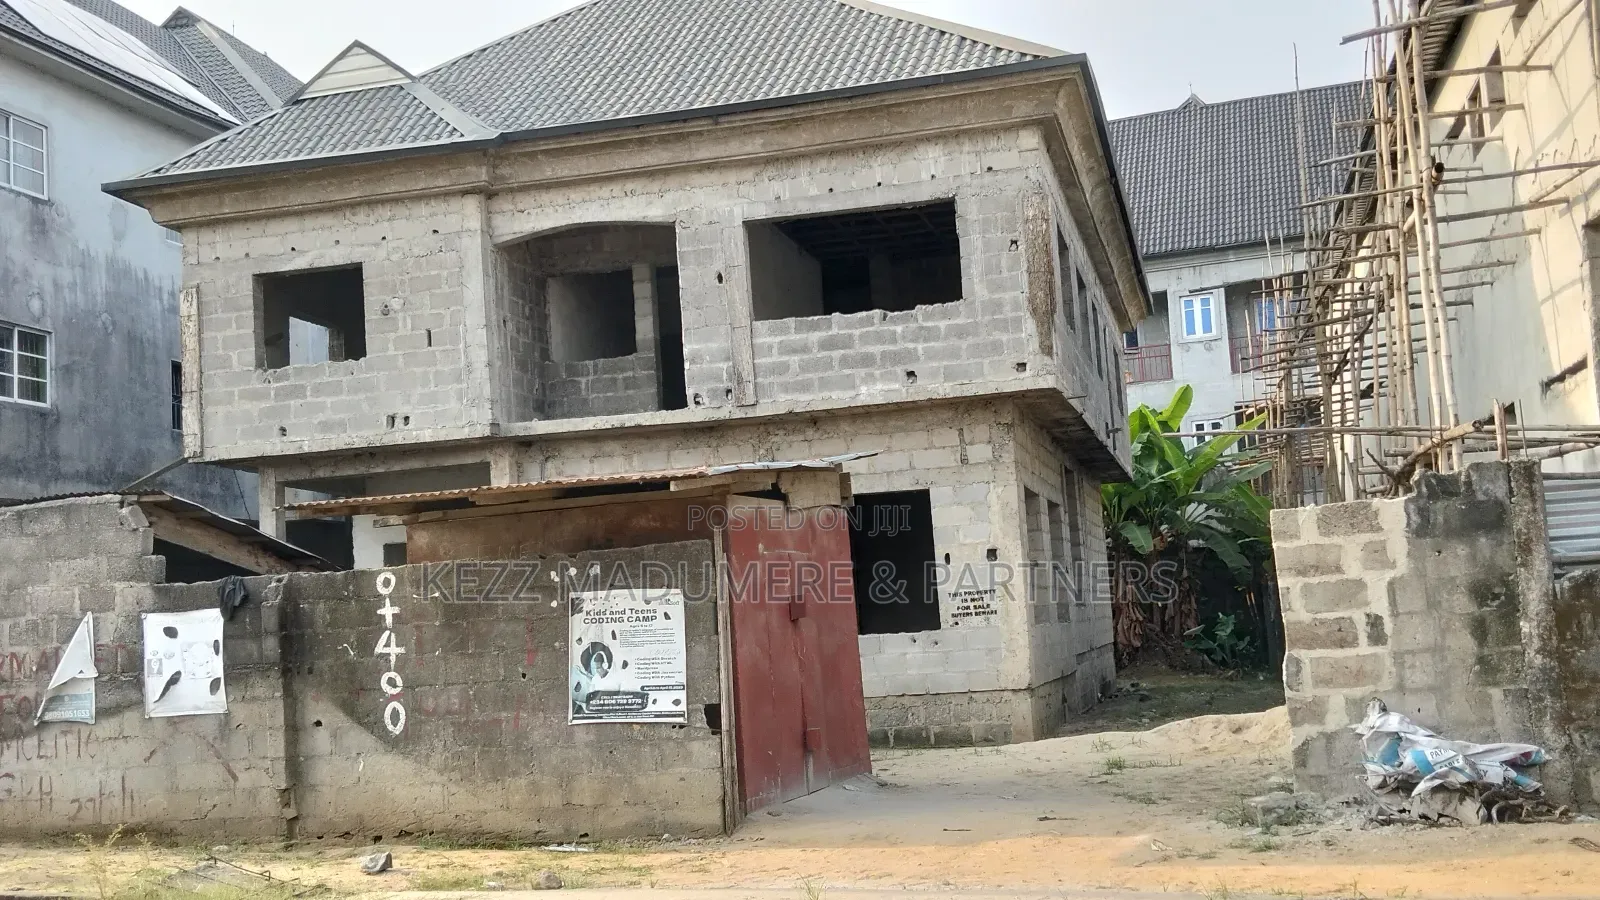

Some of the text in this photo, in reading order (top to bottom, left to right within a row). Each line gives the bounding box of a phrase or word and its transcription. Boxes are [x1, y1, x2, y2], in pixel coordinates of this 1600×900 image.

[585, 607, 658, 617] Kids and Teens
[583, 615, 658, 625] CODING CAMP
